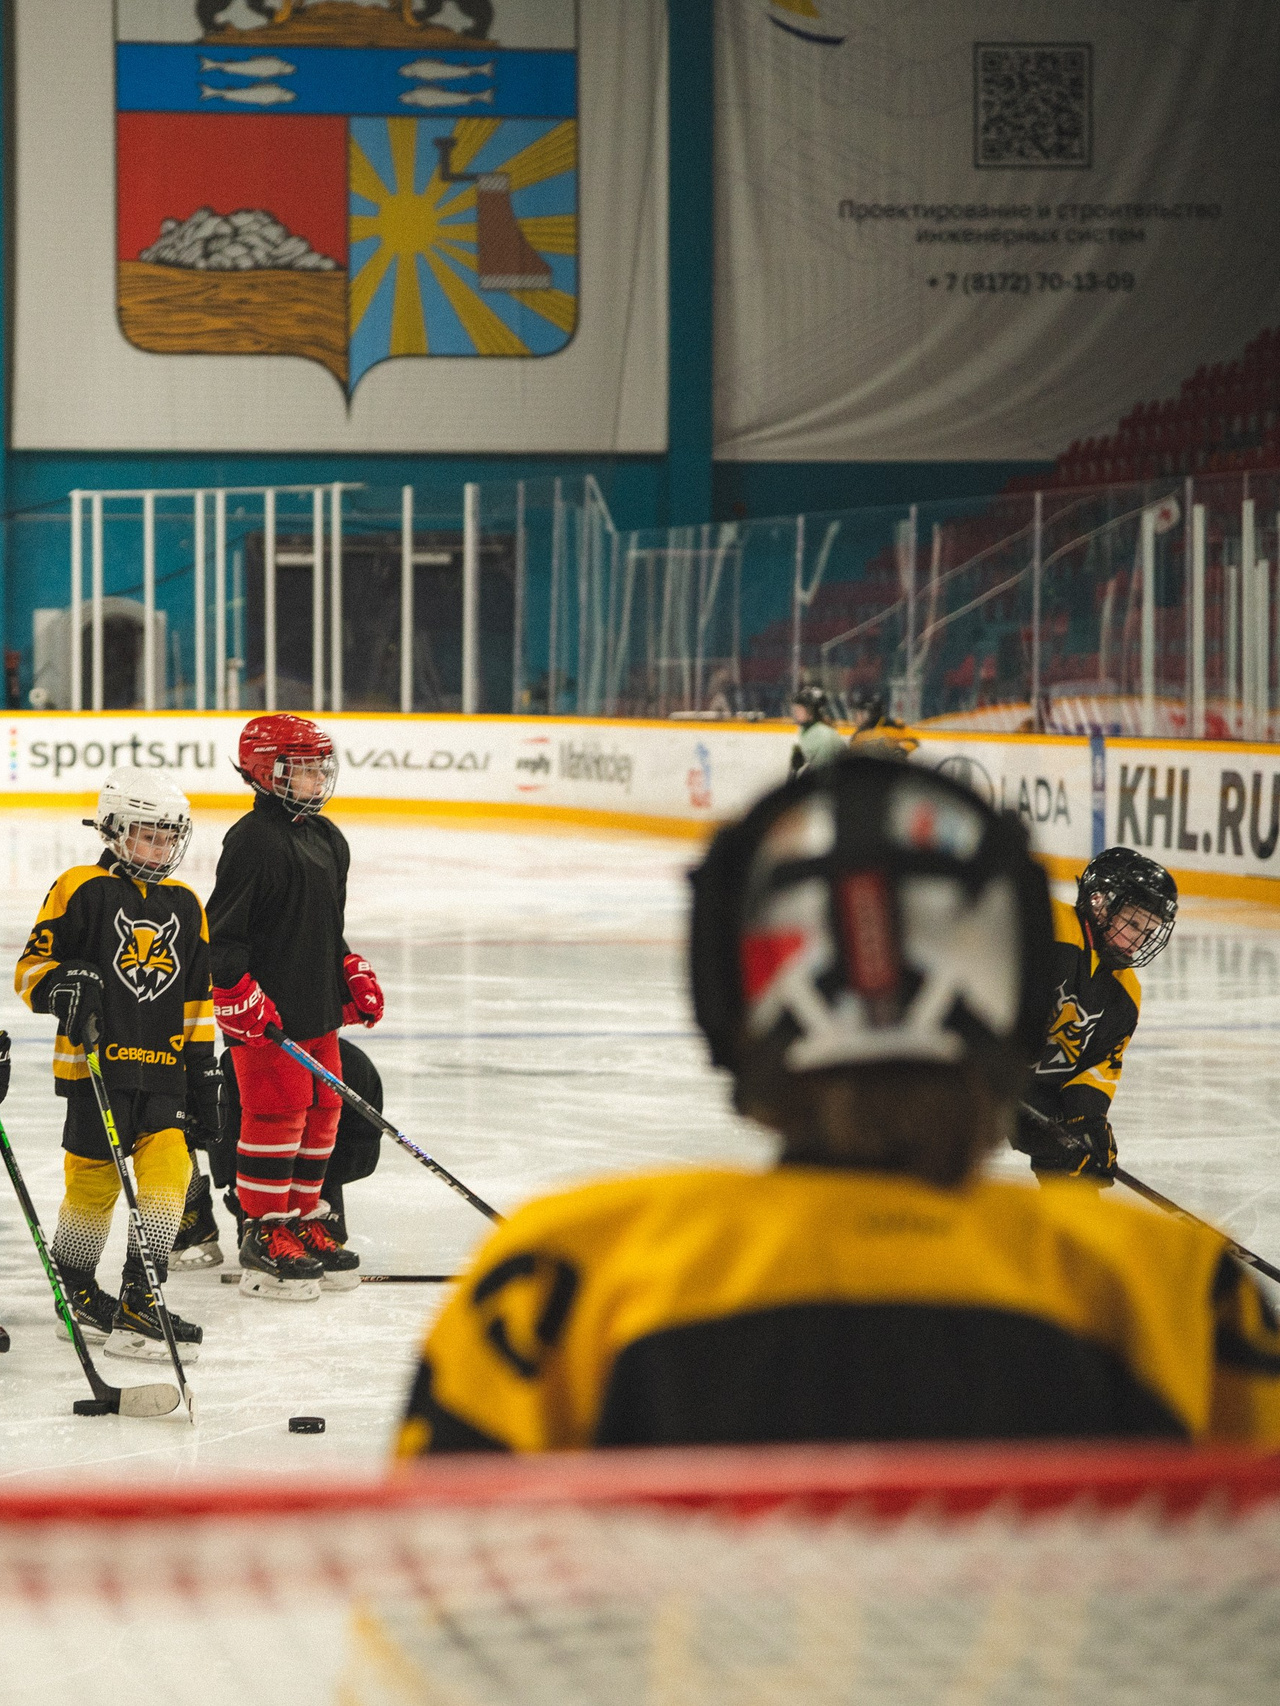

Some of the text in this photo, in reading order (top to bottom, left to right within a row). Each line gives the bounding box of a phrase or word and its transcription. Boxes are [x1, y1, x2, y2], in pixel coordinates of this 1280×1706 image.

[837, 200, 1221, 223] Проектирование и строительство
[914, 228, 1146, 247] инженерных систем
[961, 271, 1032, 294] (8172)
[1036, 272, 1136, 292] 70-13-09
[29, 733, 216, 776] sports.ru
[344, 748, 492, 773] VALDAI
[1119, 763, 1280, 859] KHL.RU
